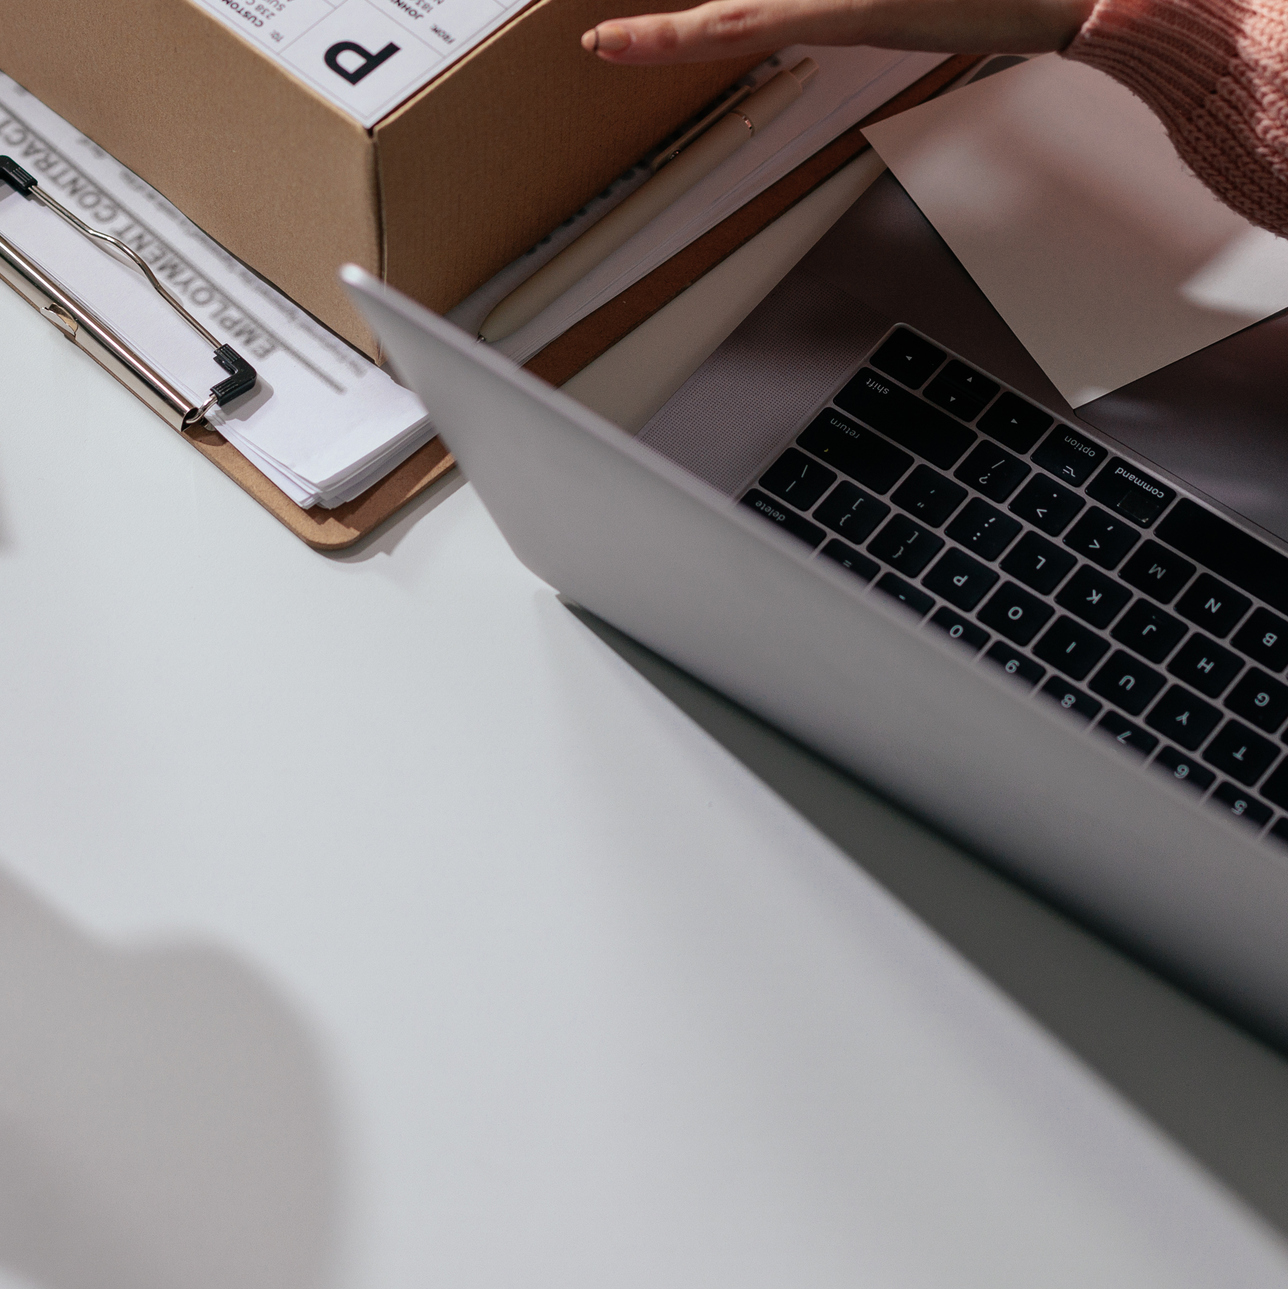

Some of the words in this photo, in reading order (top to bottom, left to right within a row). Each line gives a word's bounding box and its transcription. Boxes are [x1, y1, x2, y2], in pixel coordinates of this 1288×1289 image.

[253, 3, 276, 20] 238
[322, 39, 402, 87] P
[110, 221, 281, 360] EMPLOYMENT
[865, 377, 891, 396] shift
[829, 416, 861, 440] return
[1063, 434, 1097, 458] option
[1113, 465, 1166, 499] command
[754, 499, 787, 522] delete
[1035, 554, 1047, 570] L
[1147, 562, 1167, 580] M
[951, 574, 969, 588] P
[1085, 588, 1103, 605] K
[1203, 596, 1223, 614] N
[1141, 623, 1158, 636] J
[1261, 631, 1279, 648] B
[1005, 658, 1020, 674] 9
[1196, 656, 1215, 674] H
[1117, 673, 1137, 691] U
[1061, 693, 1076, 708] 8
[1253, 691, 1271, 708] G
[1174, 710, 1191, 726] Y
[1231, 745, 1248, 761] T
[1174, 765, 1189, 780] 6
[1231, 799, 1248, 815] 5
